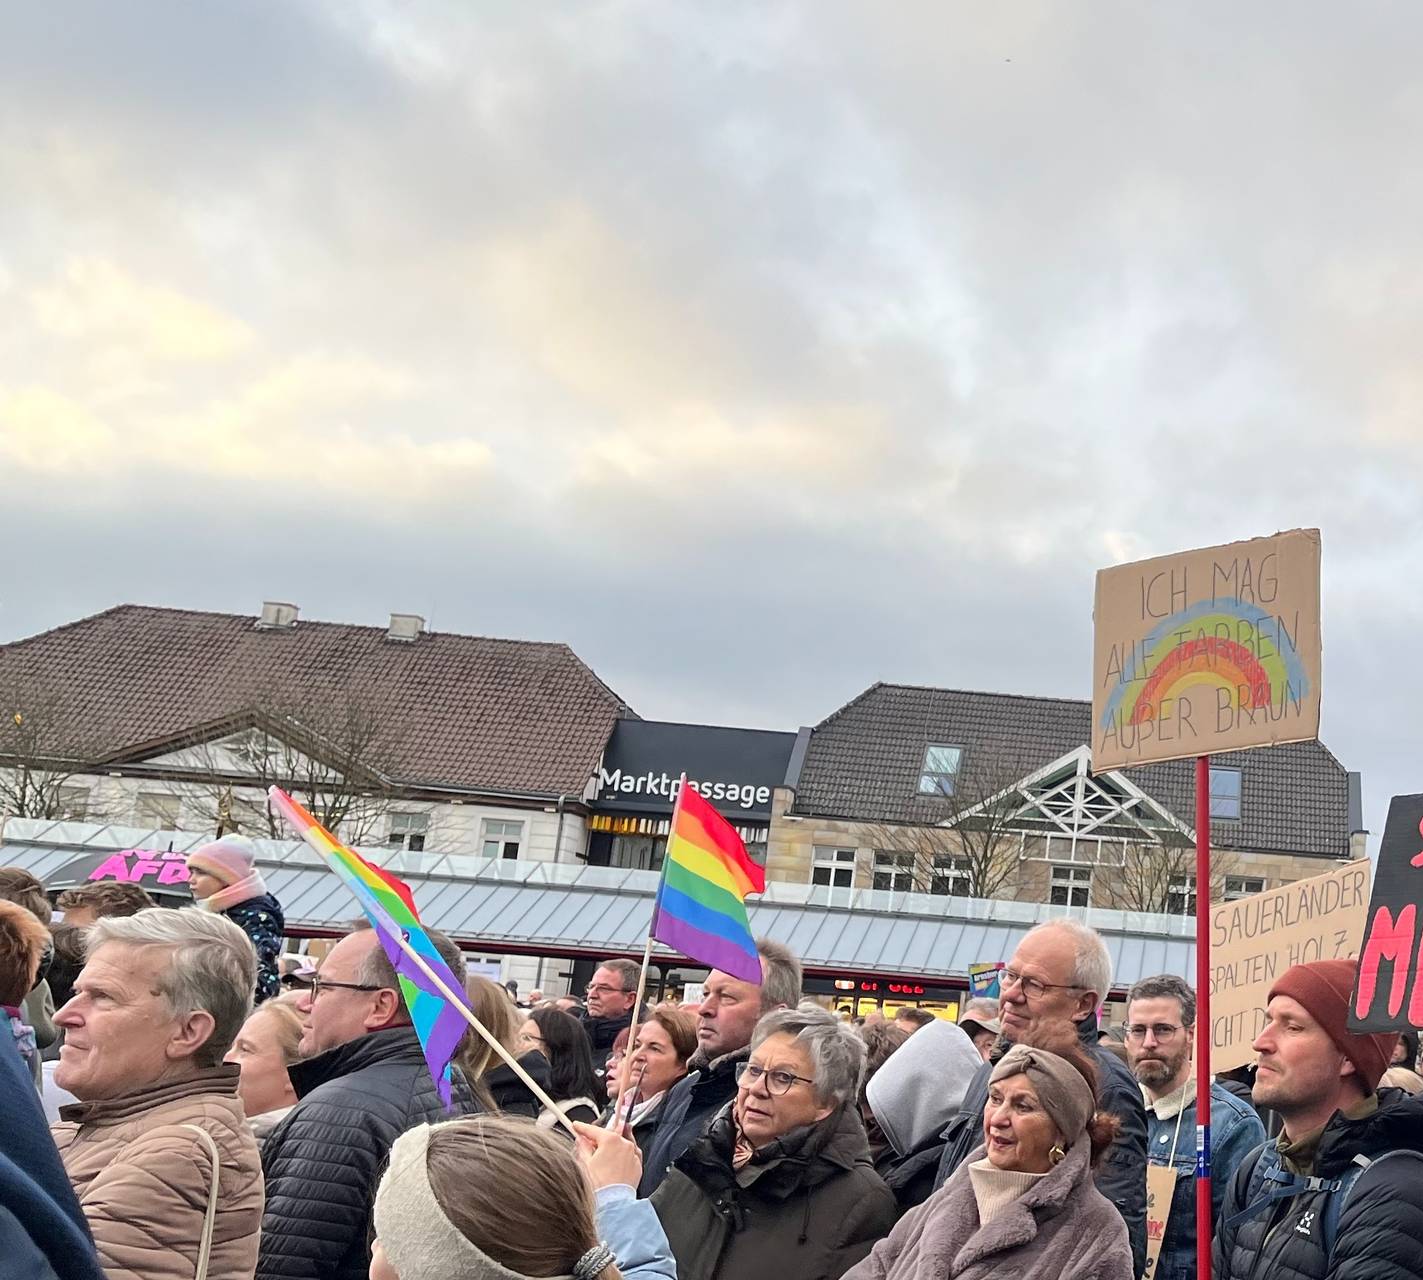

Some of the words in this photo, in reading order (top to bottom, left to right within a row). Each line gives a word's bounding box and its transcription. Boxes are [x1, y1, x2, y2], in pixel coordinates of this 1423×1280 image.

[1141, 566, 1188, 620] ICH
[1212, 553, 1279, 608] MAG
[1104, 637, 1157, 688] ALLE
[1174, 611, 1299, 670] FARBEN
[1215, 679, 1302, 734] BRAUN
[1211, 870, 1366, 948] SAUERLÄNDER
[1210, 1008, 1249, 1049] ICHT
